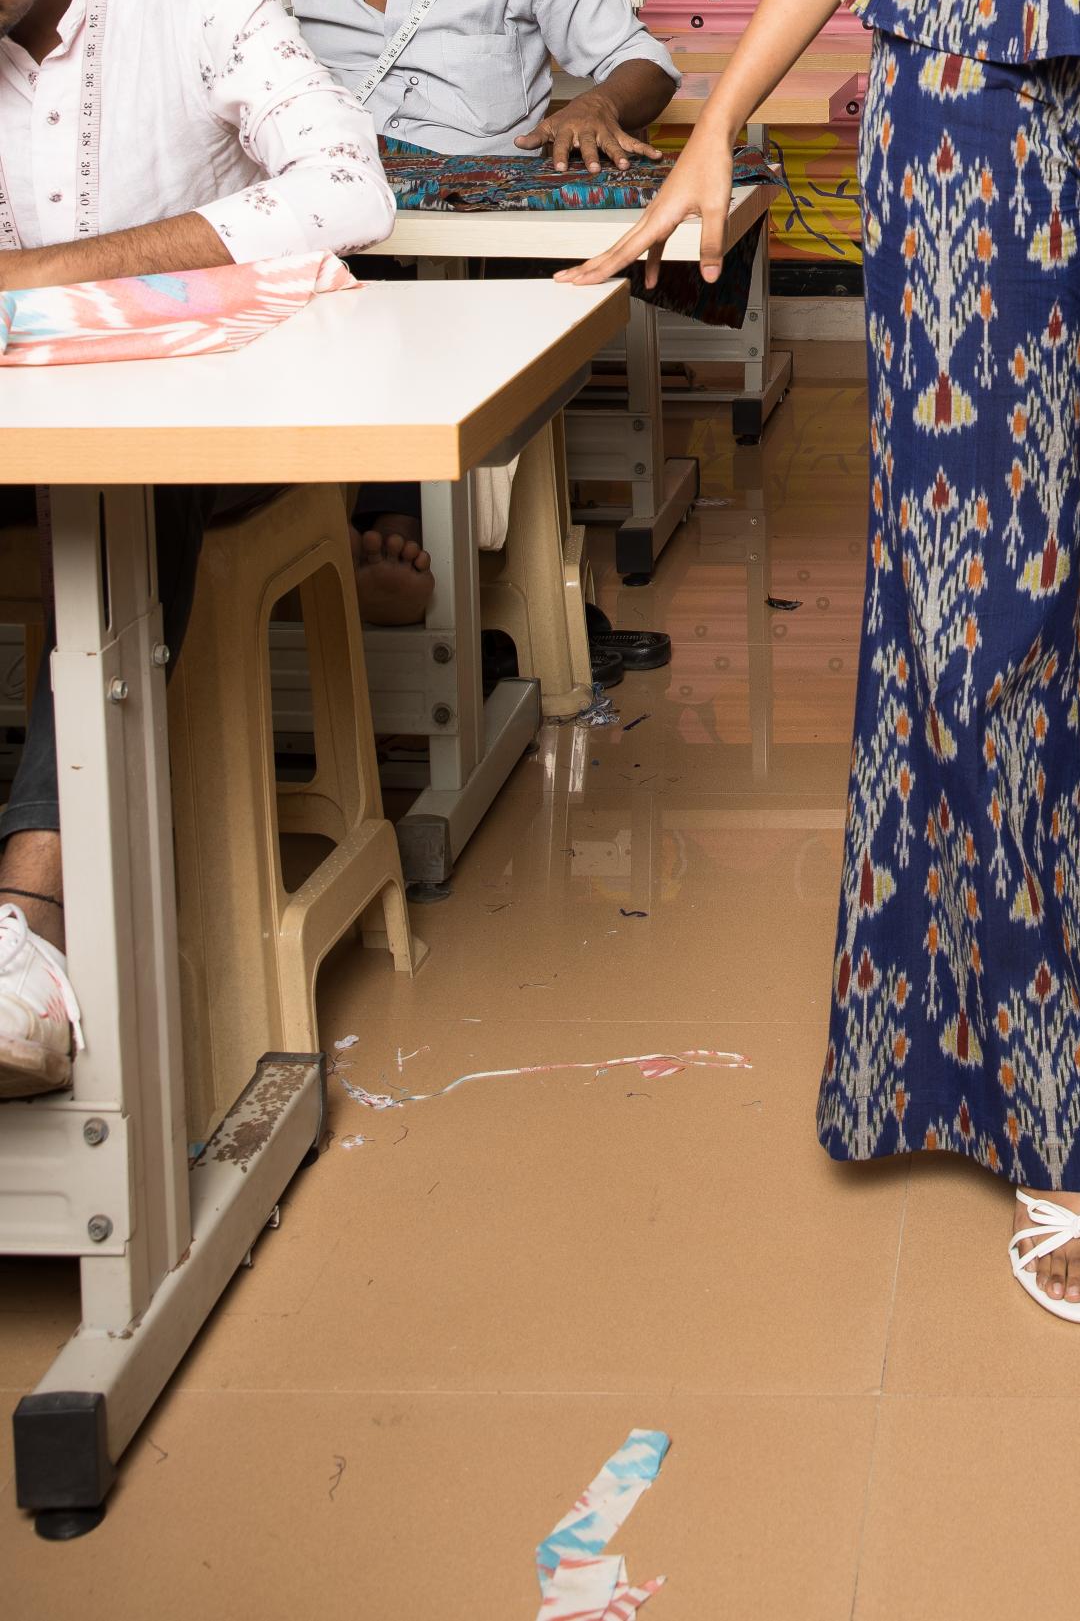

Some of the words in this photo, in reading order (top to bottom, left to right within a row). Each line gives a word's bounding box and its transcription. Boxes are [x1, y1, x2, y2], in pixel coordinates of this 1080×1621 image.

[89, 14, 98, 28] 34
[86, 44, 95, 58] 35
[364, 80, 374, 90] 40
[376, 65, 386, 75] 41
[388, 48, 398, 59] 42
[399, 32, 409, 42] 43
[410, 16, 420, 26] 44
[421, 0, 431, 10] 45
[85, 73, 94, 88] 36
[83, 102, 93, 117] 37
[82, 132, 91, 147] 38
[81, 161, 90, 176] 39
[80, 191, 90, 206] 40
[3, 221, 13, 233] 15
[79, 221, 90, 233] 41
